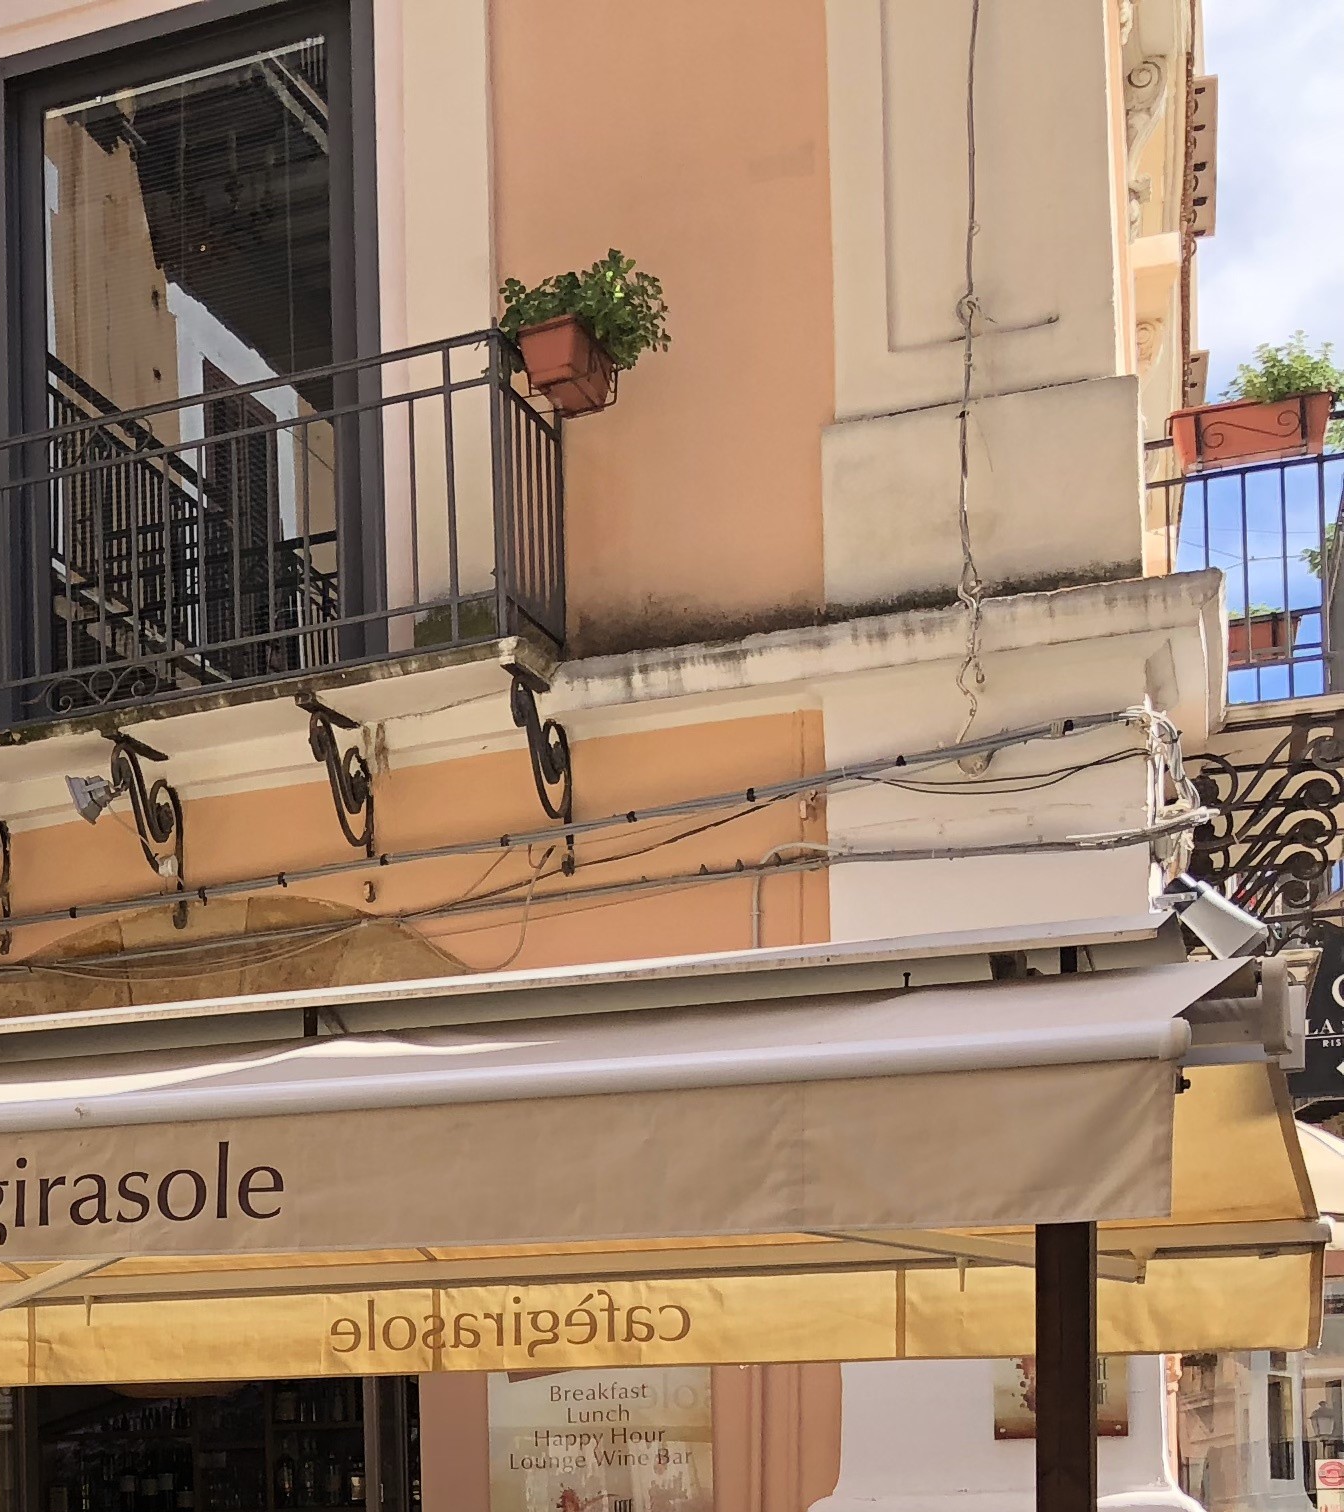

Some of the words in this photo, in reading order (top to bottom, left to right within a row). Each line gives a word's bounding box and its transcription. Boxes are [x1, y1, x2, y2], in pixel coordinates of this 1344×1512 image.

[549, 1382, 649, 1402] Breakfast
[567, 1404, 631, 1424] Lunch
[534, 1429, 604, 1451] Happy
[611, 1427, 665, 1445] Hour
[509, 1453, 587, 1471] Lounge
[593, 1450, 649, 1467] Wine
[656, 1448, 693, 1466] Bar
